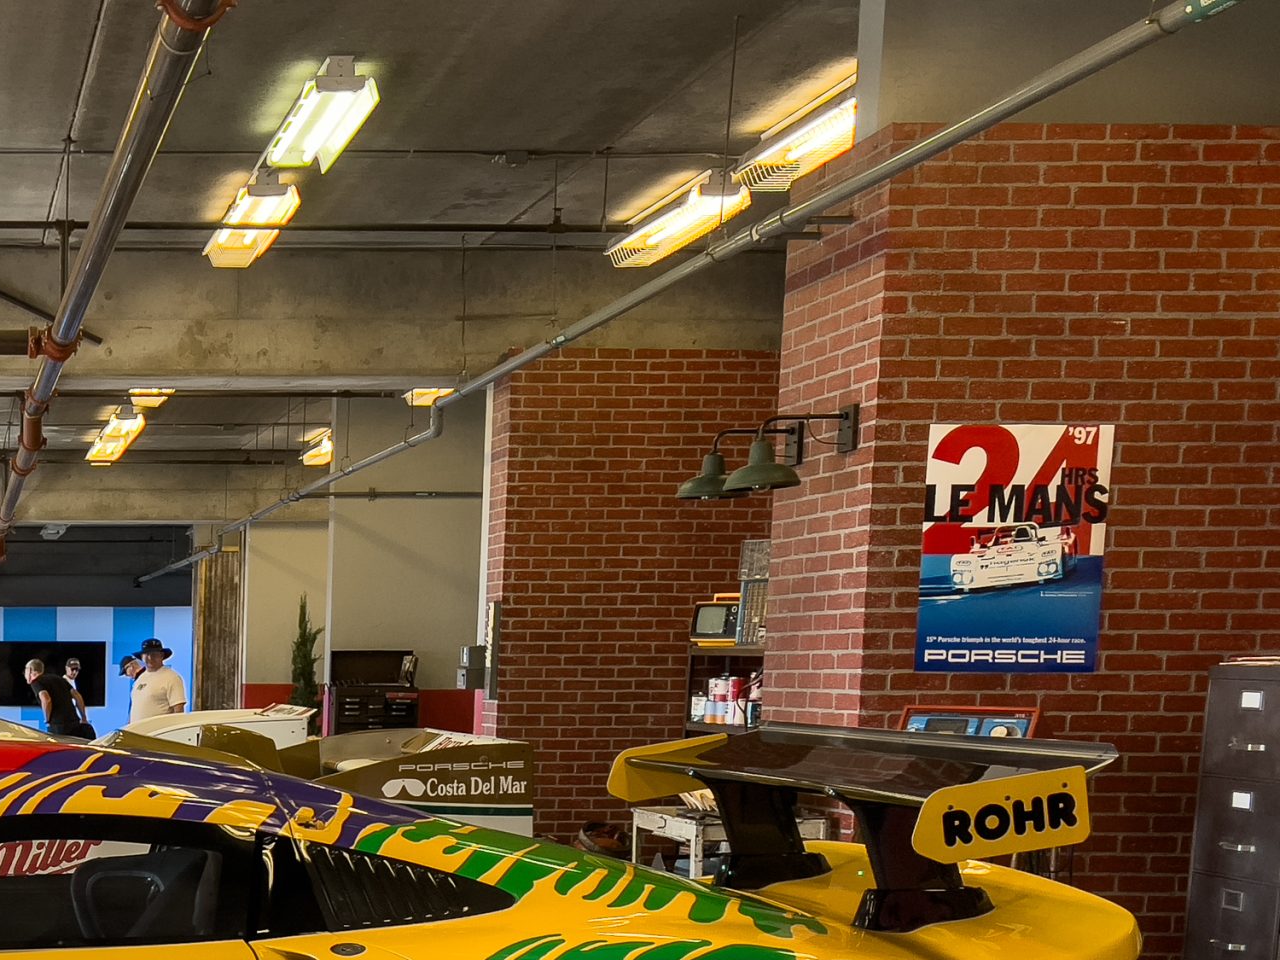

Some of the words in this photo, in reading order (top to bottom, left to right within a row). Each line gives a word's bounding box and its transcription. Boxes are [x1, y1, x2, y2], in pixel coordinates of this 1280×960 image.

[1061, 467, 1099, 485] HRS
[924, 484, 976, 522] LE
[987, 484, 1109, 524] MANS
[924, 649, 1086, 663] PORSCHE
[399, 761, 525, 772] PORSCHE
[426, 778, 466, 797] Costa
[470, 776, 495, 795] Del
[499, 775, 527, 794] Mar
[942, 792, 1078, 848] ROHR
